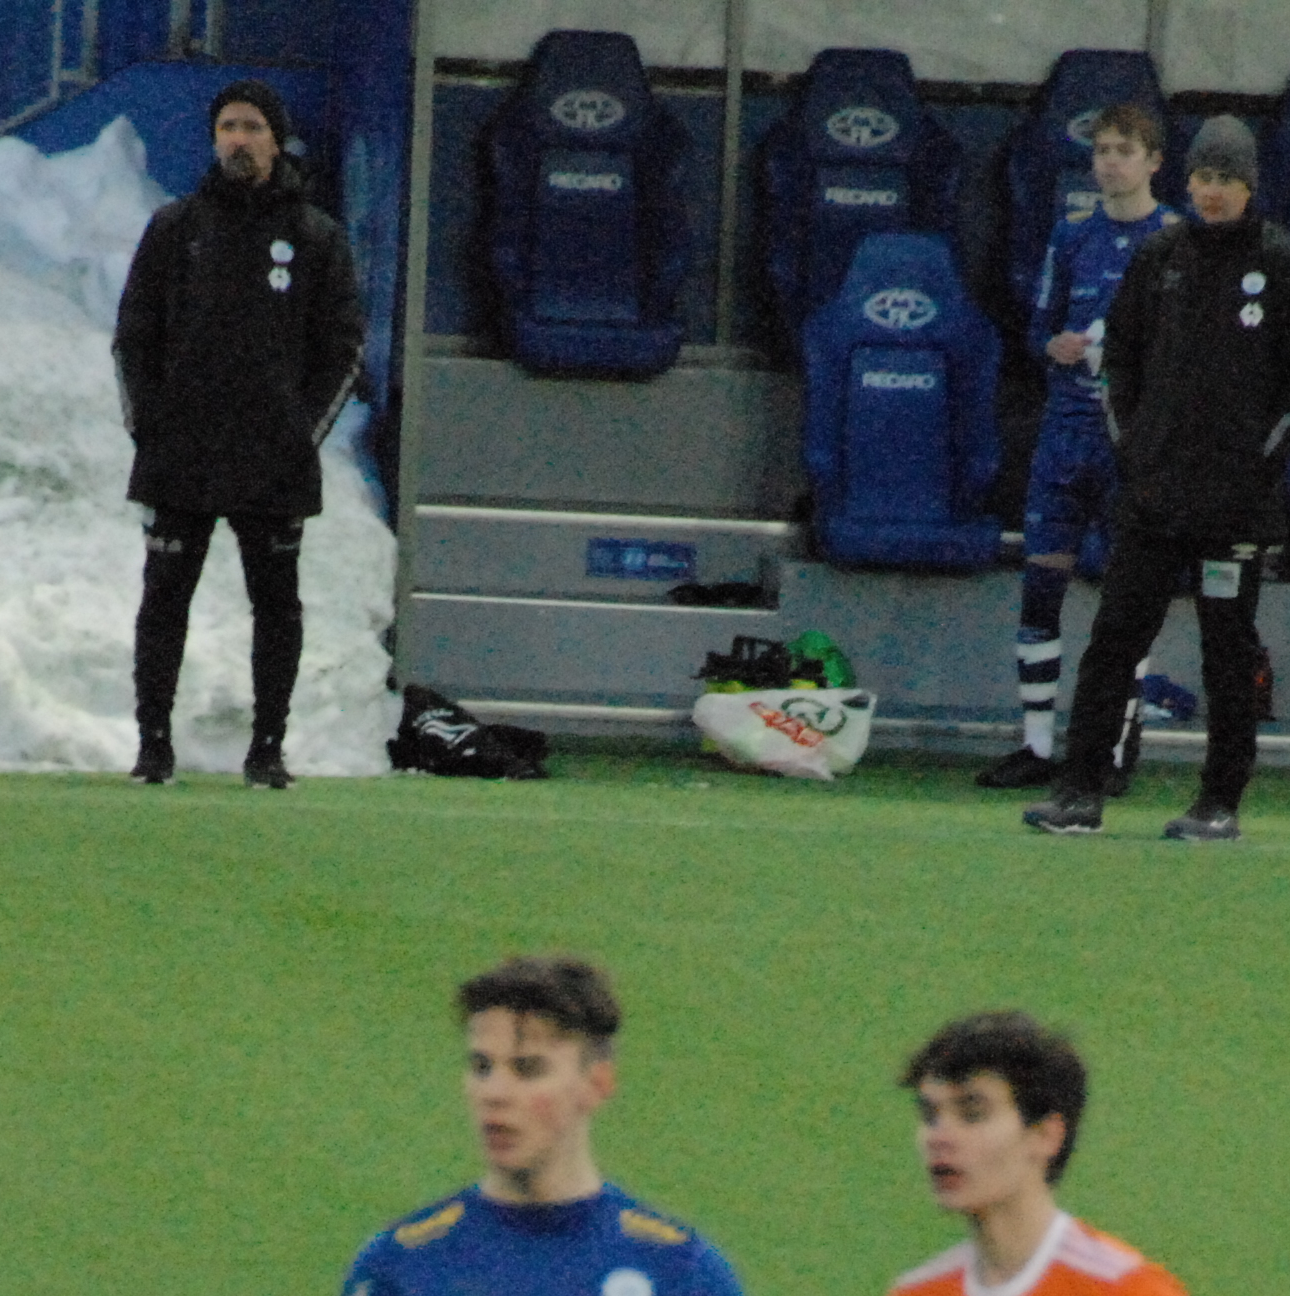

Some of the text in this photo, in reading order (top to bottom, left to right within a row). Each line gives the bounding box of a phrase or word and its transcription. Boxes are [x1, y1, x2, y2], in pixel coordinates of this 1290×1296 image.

[549, 172, 623, 190] RECARO
[825, 187, 898, 206] RECARO
[862, 371, 935, 389] RECARO
